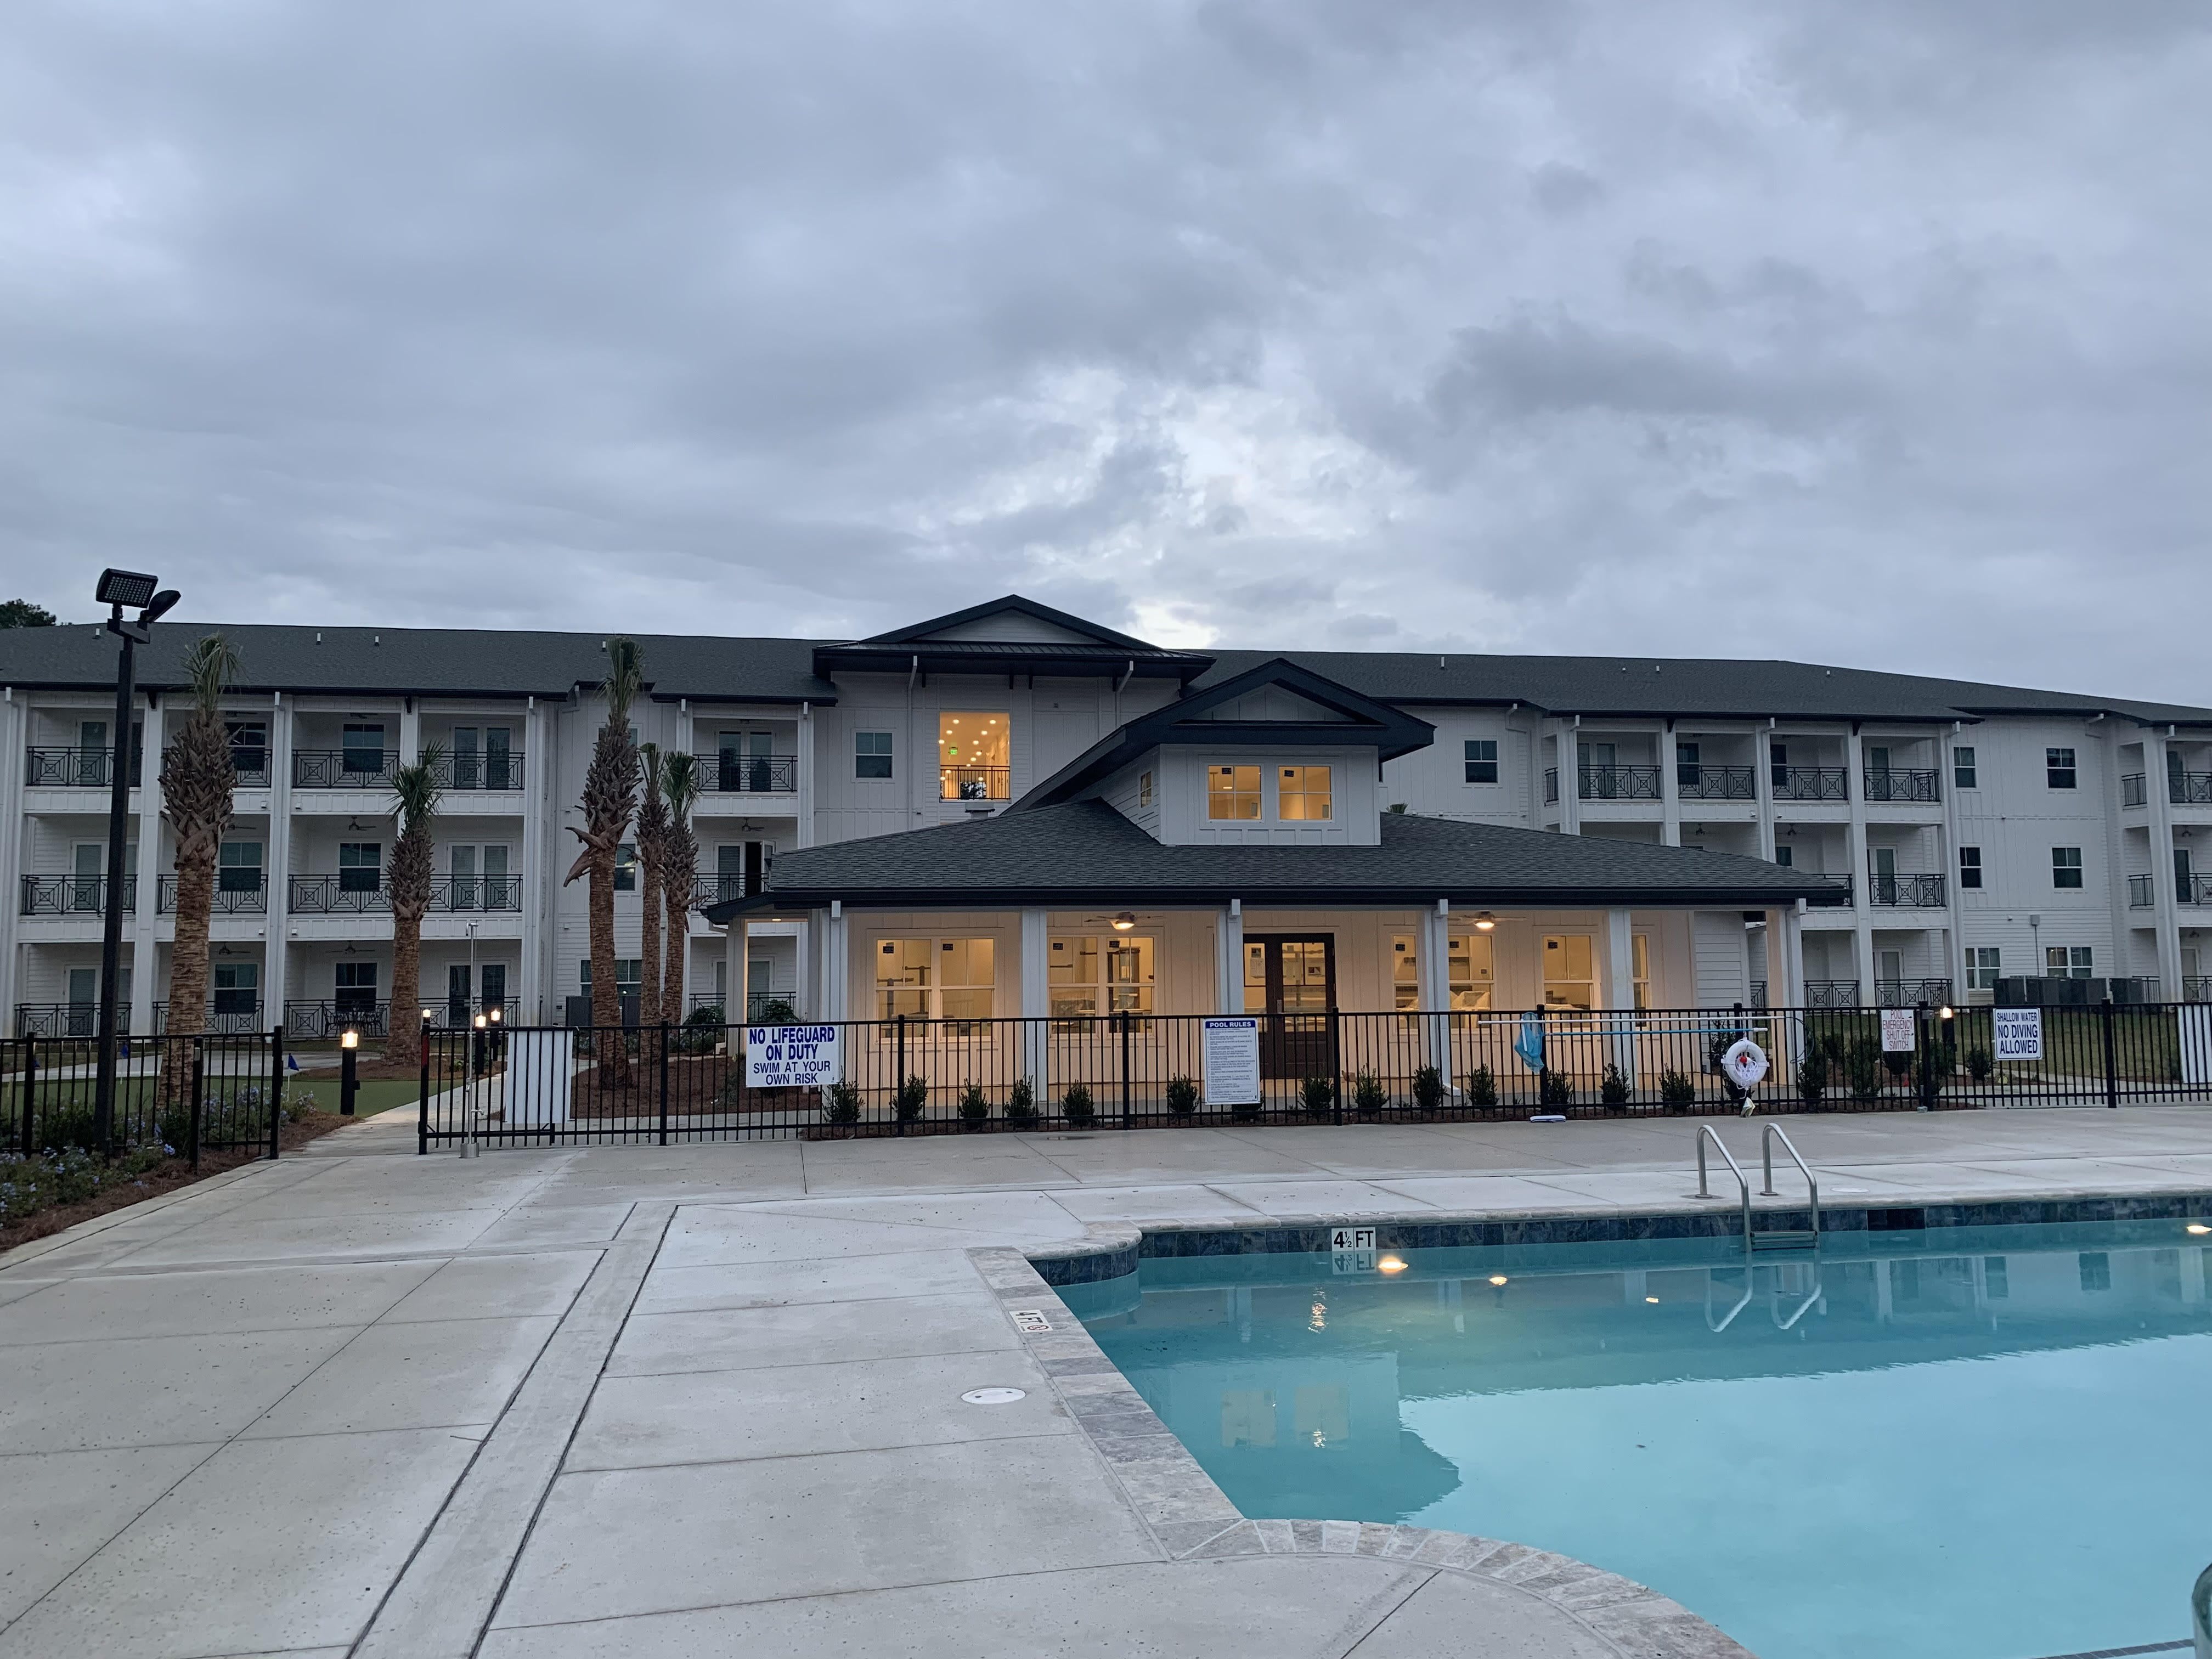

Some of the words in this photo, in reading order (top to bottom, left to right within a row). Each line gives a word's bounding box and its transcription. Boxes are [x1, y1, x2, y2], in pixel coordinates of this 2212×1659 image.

[1891, 1009, 1904, 1019] POOL
[1997, 1012, 2019, 1022] SHALLOW
[2021, 1012, 2037, 1022] WATER
[1883, 1020, 1913, 1030] EMERGENCY
[1997, 1024, 2009, 1039] NO
[2011, 1024, 2038, 1038] DIVING
[749, 1028, 766, 1044] NO
[771, 1026, 835, 1043] LIFEGUARD
[1887, 1030, 1900, 1040] SHUT
[1901, 1030, 1910, 1040] OFF
[766, 1045, 782, 1060] ON
[788, 1043, 819, 1060] DUTY
[1889, 1040, 1909, 1050] SWITCH
[2000, 1040, 2038, 1054] ALLOWED
[753, 1062, 780, 1074] SWIM
[785, 1062, 798, 1073] AT
[803, 1060, 831, 1072] YOUR
[766, 1074, 789, 1085] OWN
[795, 1073, 818, 1084] RISK
[1356, 1230, 1374, 1248] FT
